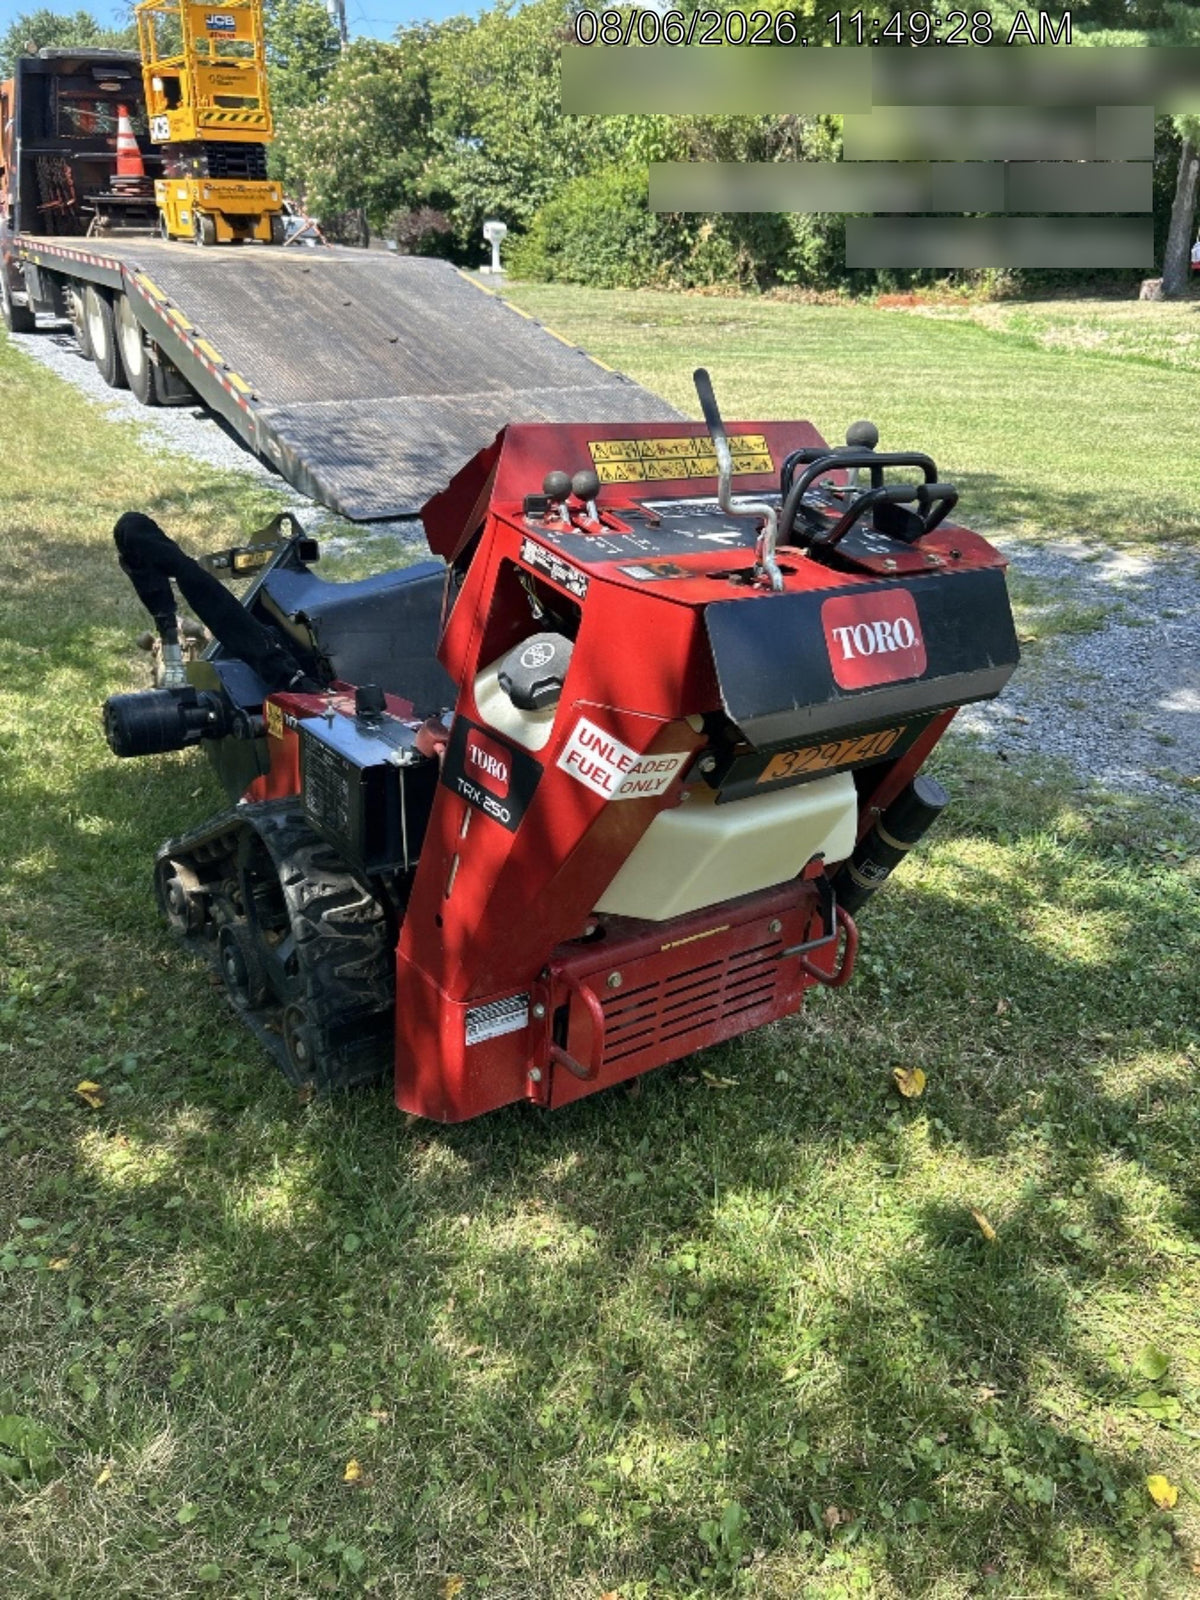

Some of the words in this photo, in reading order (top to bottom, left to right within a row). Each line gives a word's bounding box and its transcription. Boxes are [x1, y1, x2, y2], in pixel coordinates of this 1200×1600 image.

[205, 14, 236, 26] JCB
[832, 617, 915, 660] TORO
[469, 744, 508, 782] TORO
[566, 749, 612, 792] FUEL
[619, 777, 668, 794] ONLY
[578, 727, 679, 775] UNLEADED
[771, 727, 900, 778] 329740
